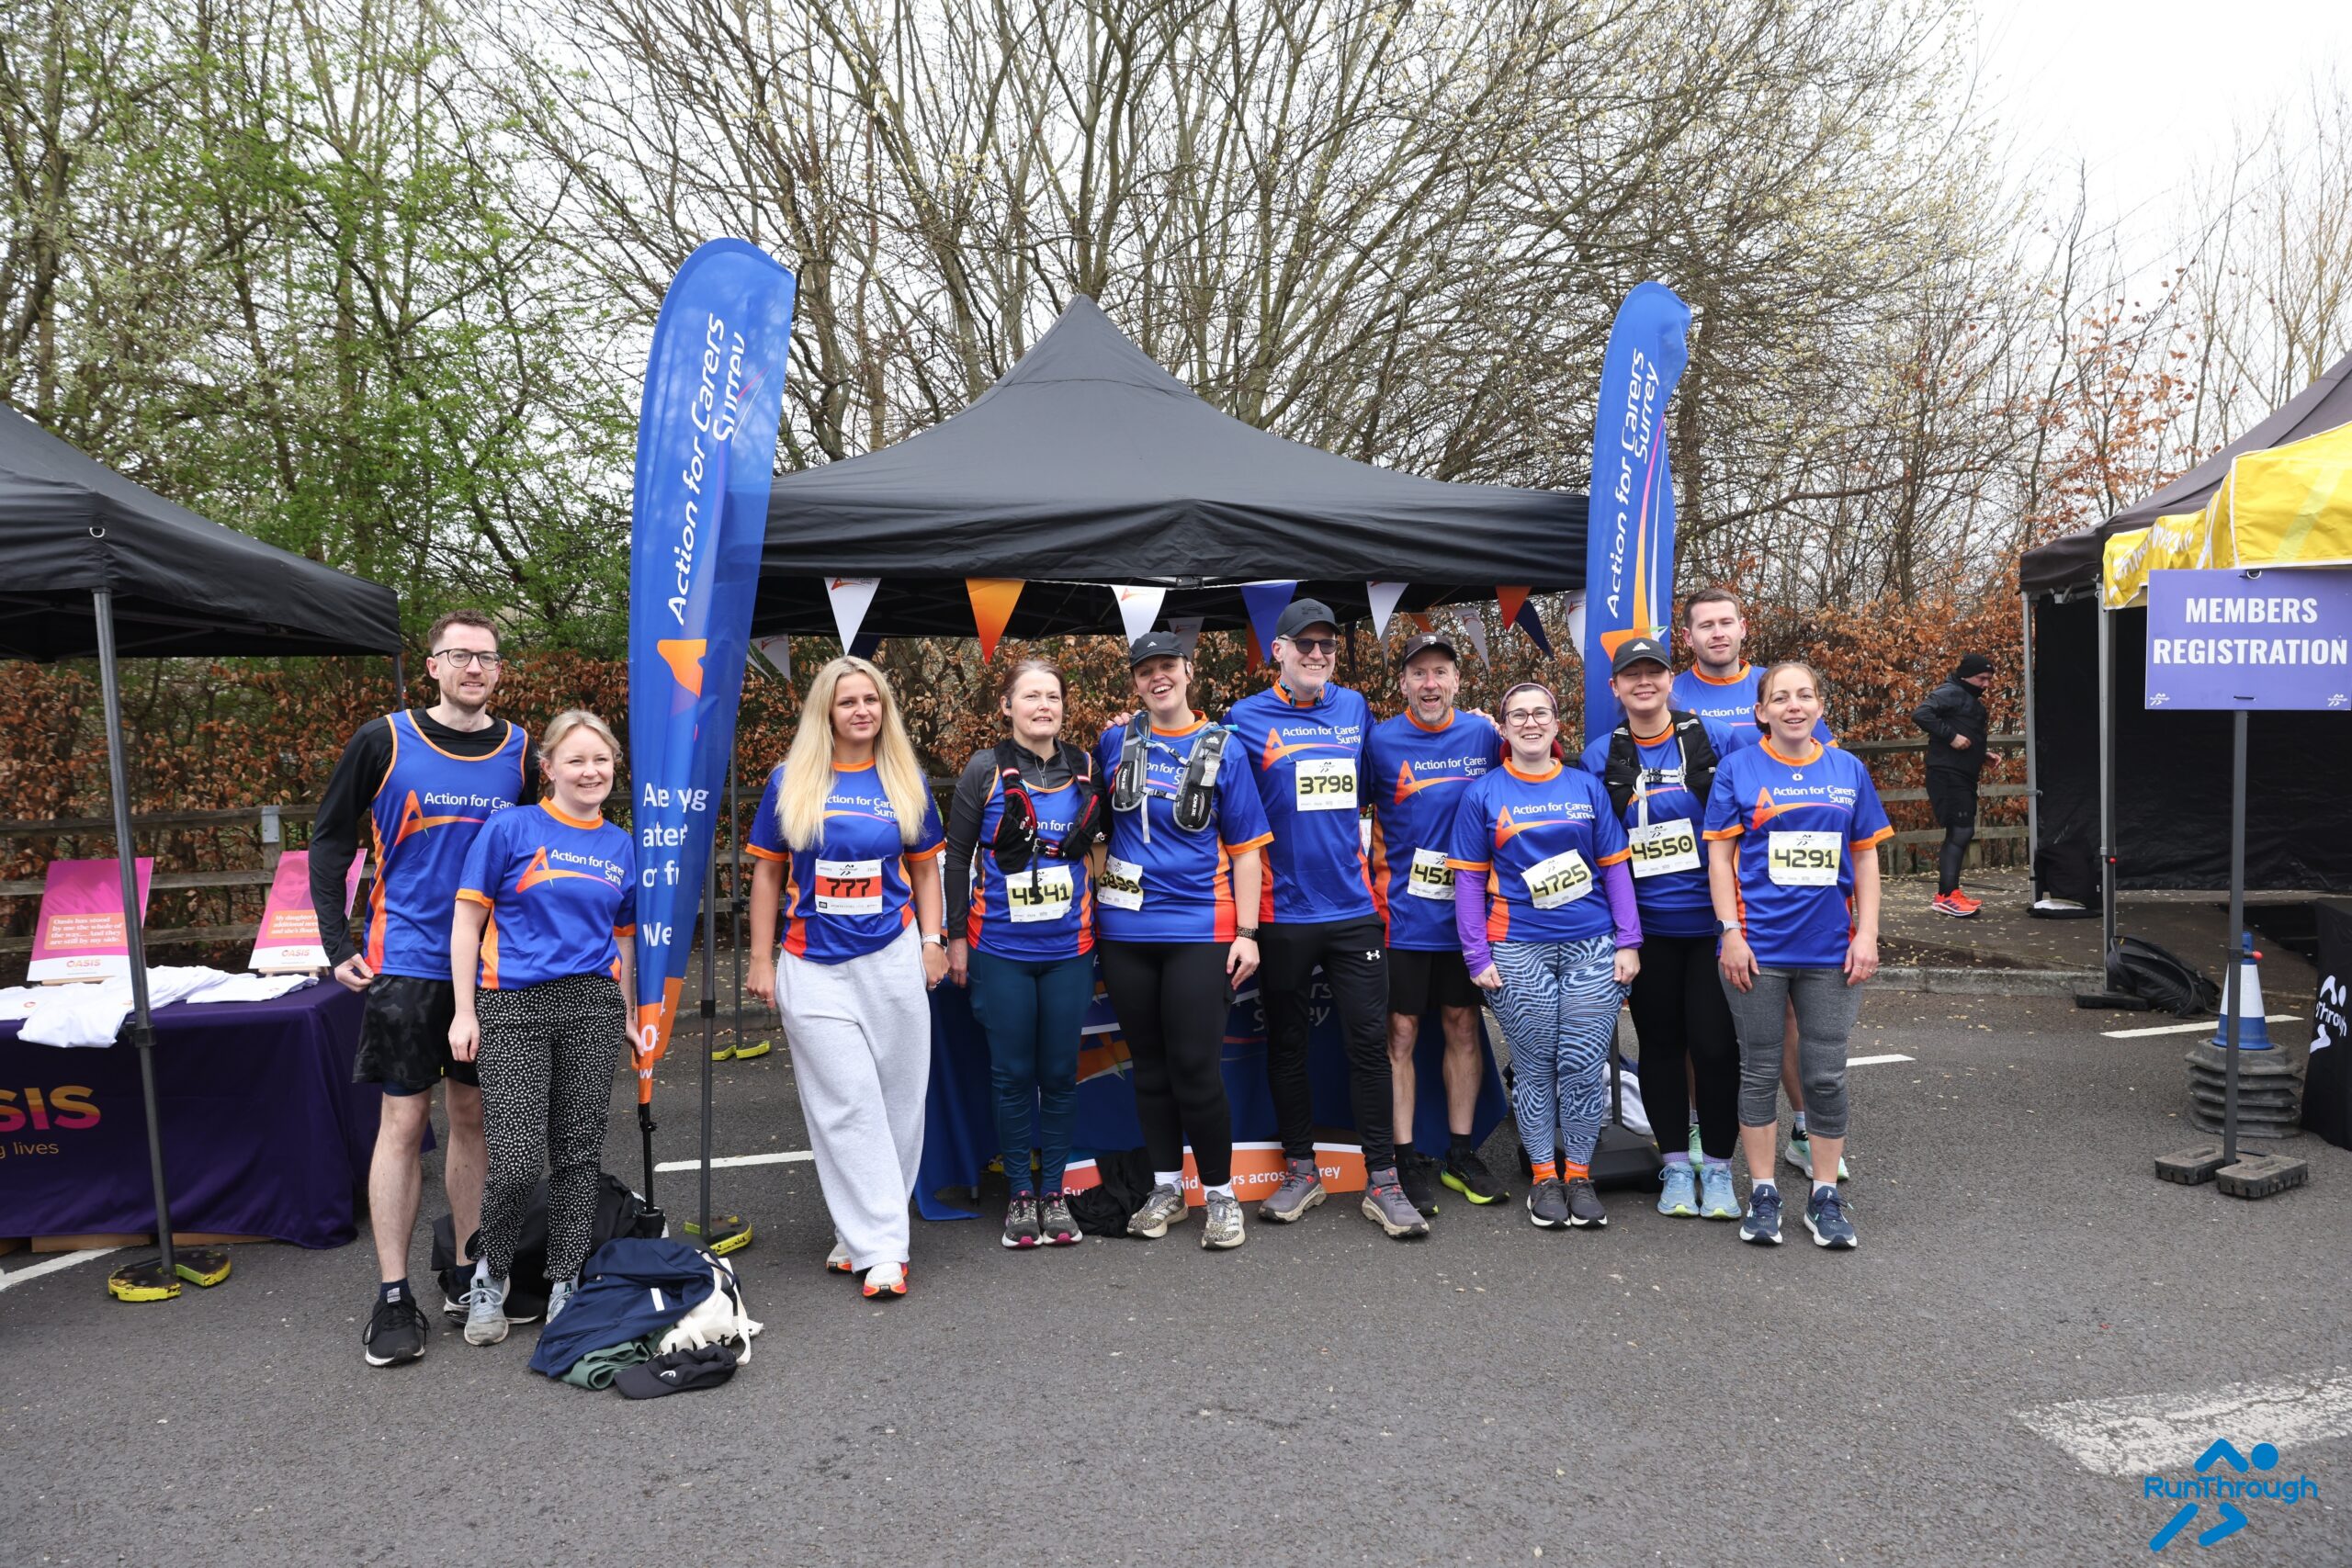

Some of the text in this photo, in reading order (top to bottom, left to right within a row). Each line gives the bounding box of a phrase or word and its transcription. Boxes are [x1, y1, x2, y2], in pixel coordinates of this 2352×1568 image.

[1635, 361, 1659, 464] Surrey
[669, 312, 725, 626] Action for Carers
[1607, 348, 1644, 619] Action for Carers
[2186, 597, 2318, 624] MEMBERS
[2153, 638, 2348, 664] REGISTRATION
[1701, 706, 1751, 717] Action for
[1283, 725, 1360, 737] Action for Carers
[1336, 735, 1361, 744] Surrey
[1159, 762, 1176, 773] for
[1414, 756, 1487, 771] Action for Carers
[1464, 766, 1487, 777] Surrey
[1299, 774, 1354, 795] 3798
[1773, 784, 1856, 797] Action for Carers
[424, 792, 516, 809] Action for Car
[824, 795, 854, 805] ction
[856, 795, 873, 806] for
[1513, 802, 1593, 815] Action for Carers
[1828, 794, 1856, 808] Surrey
[1050, 819, 1068, 831] for
[1631, 835, 1693, 860] 4550
[550, 849, 587, 865] Action
[588, 855, 605, 868] for
[1774, 848, 1836, 869] 4291
[1414, 863, 1456, 886] 451
[1532, 863, 1588, 896] 4725
[826, 878, 871, 897] 777
[1012, 883, 1070, 906] 4541
[282, 949, 310, 957] OASIS
[66, 959, 101, 967] OASIS
[0, 1085, 101, 1133] SIS
[13, 1142, 60, 1155] lives
[1249, 1171, 1285, 1184] acros
